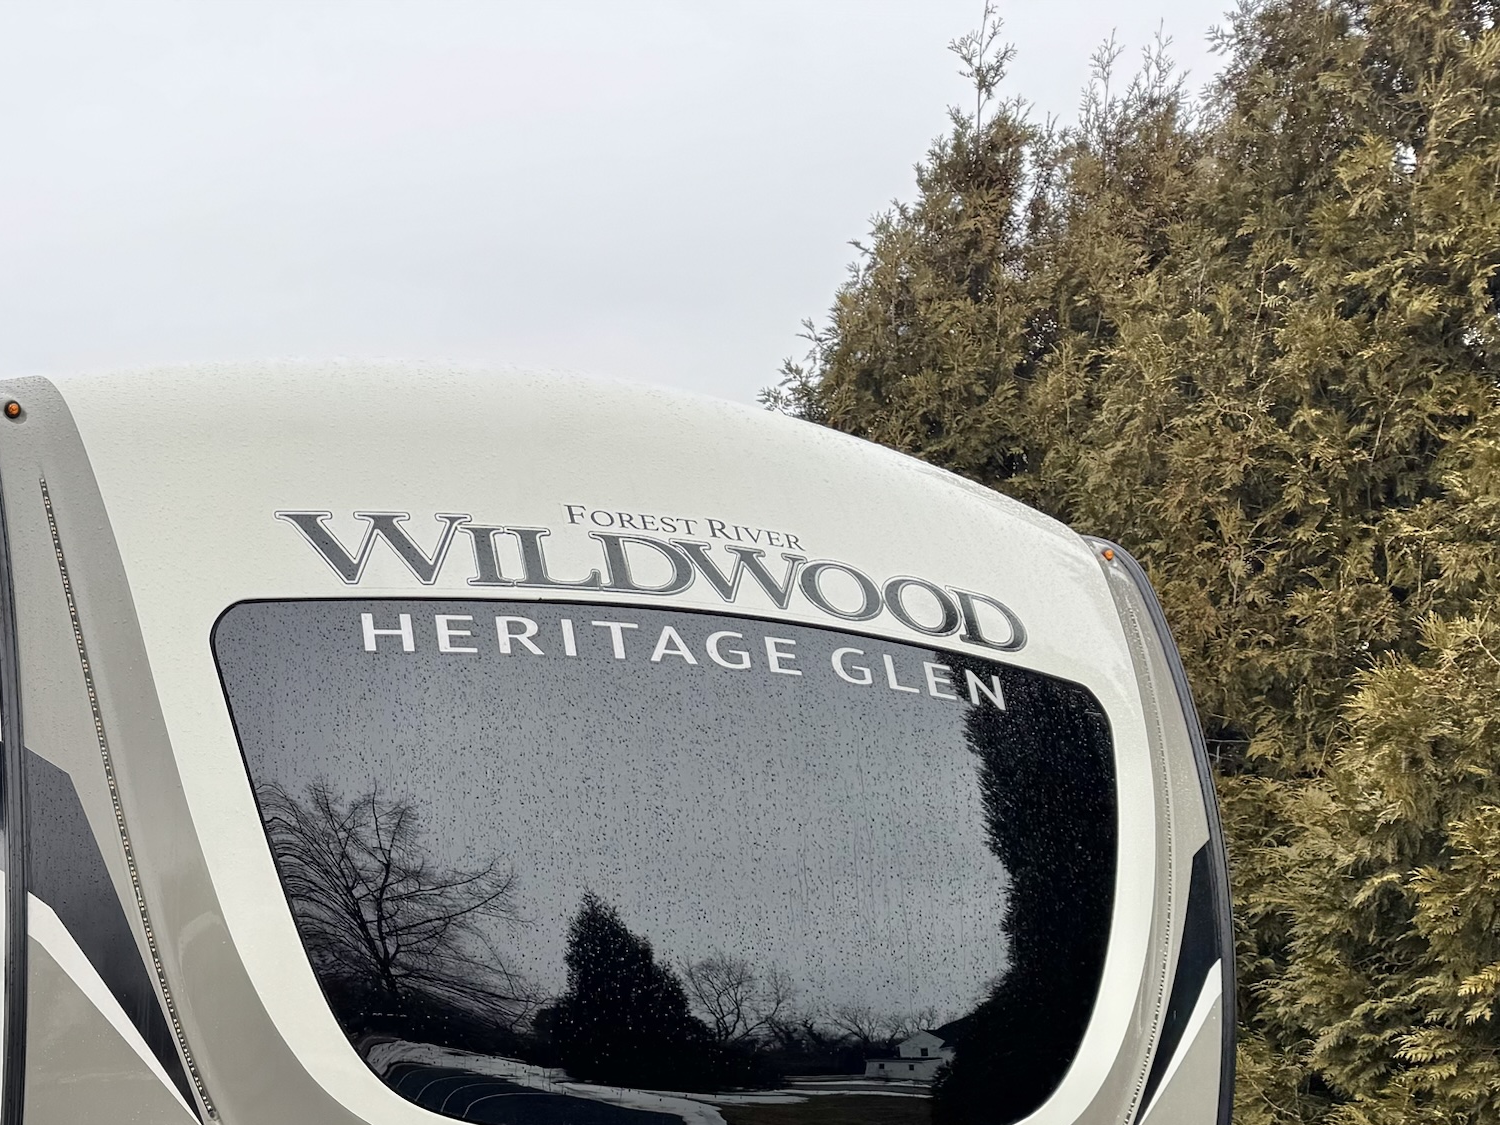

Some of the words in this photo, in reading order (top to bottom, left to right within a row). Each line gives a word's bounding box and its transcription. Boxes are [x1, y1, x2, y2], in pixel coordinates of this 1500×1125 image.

[563, 503, 698, 536] FOREST
[704, 517, 807, 552] RIVER
[274, 510, 1028, 653] WILDWOOD
[360, 612, 803, 677] HERITAGE
[830, 646, 1007, 712] GLEN
